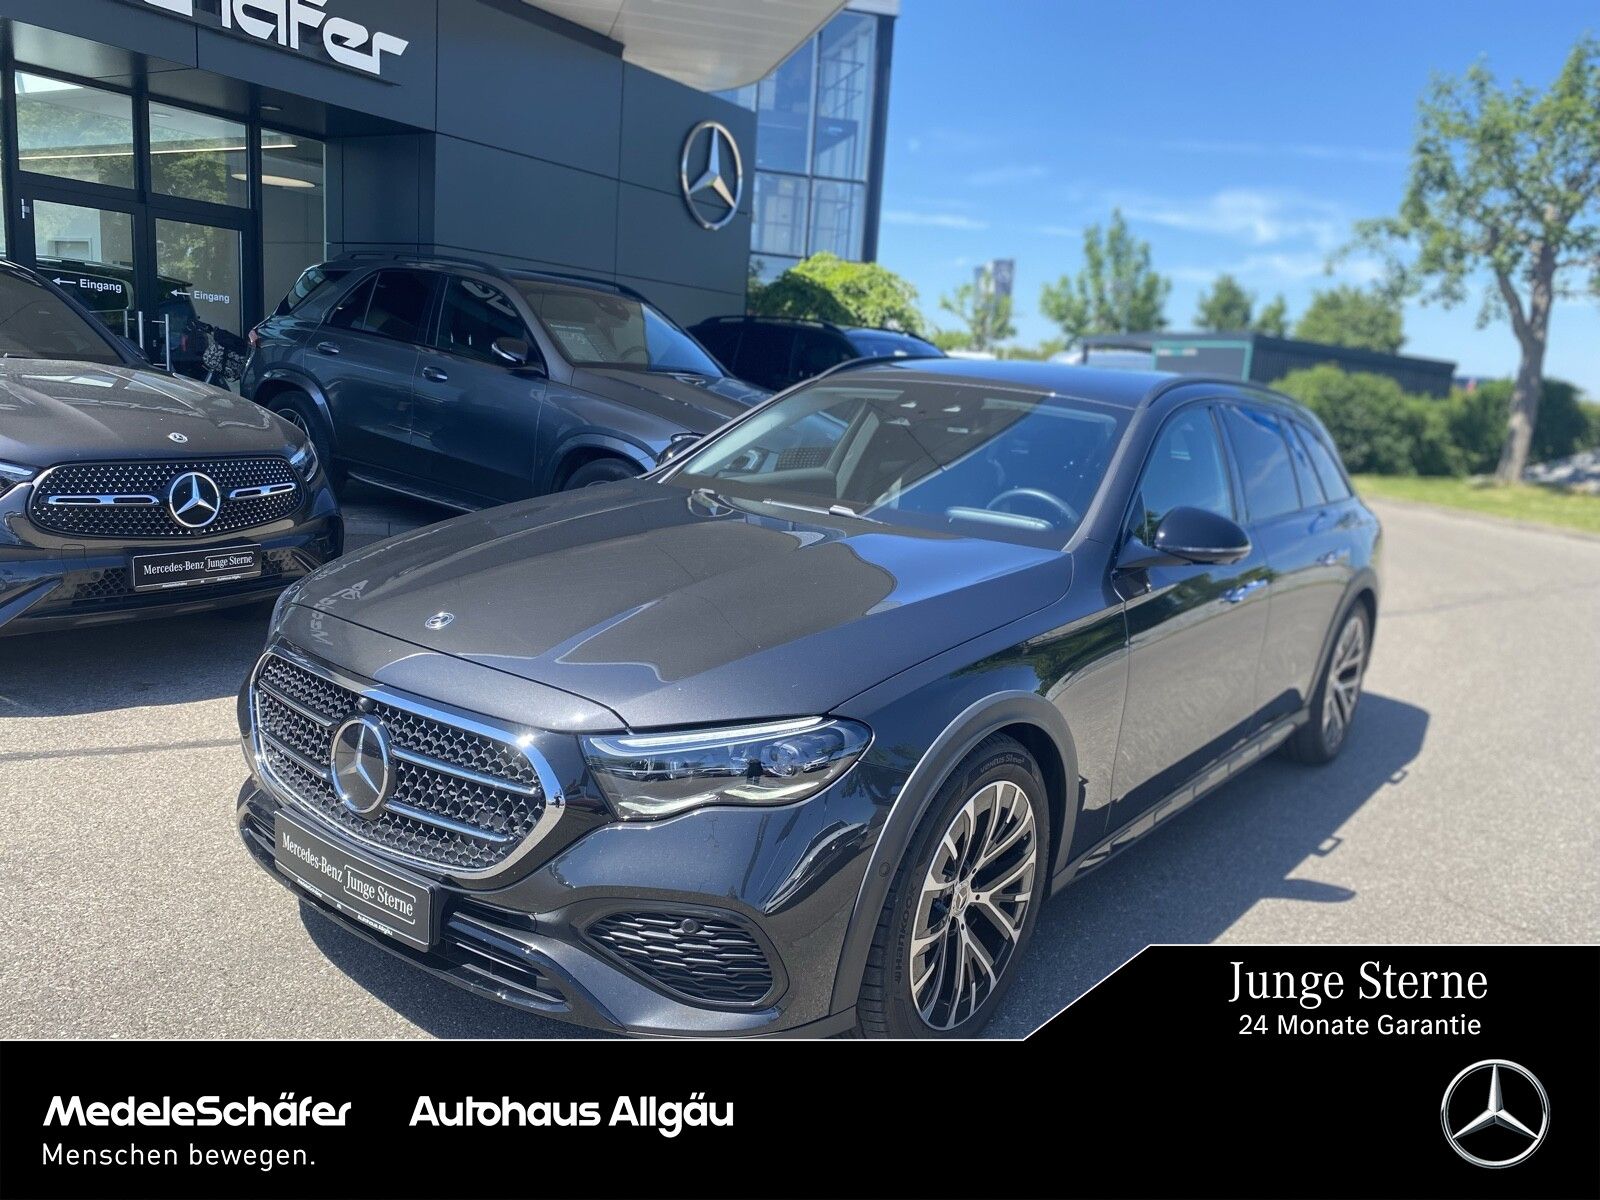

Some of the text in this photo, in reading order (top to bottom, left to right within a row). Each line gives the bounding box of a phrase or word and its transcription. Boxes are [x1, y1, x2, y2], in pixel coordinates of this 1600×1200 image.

[79, 279, 122, 293] Eingang
[193, 290, 231, 304] Eingang
[143, 555, 253, 576] Mercedes-Benz Junge Sterne
[282, 832, 343, 884] Mercedes-Benz
[346, 870, 375, 900] Junge
[377, 885, 414, 917] Sterne
